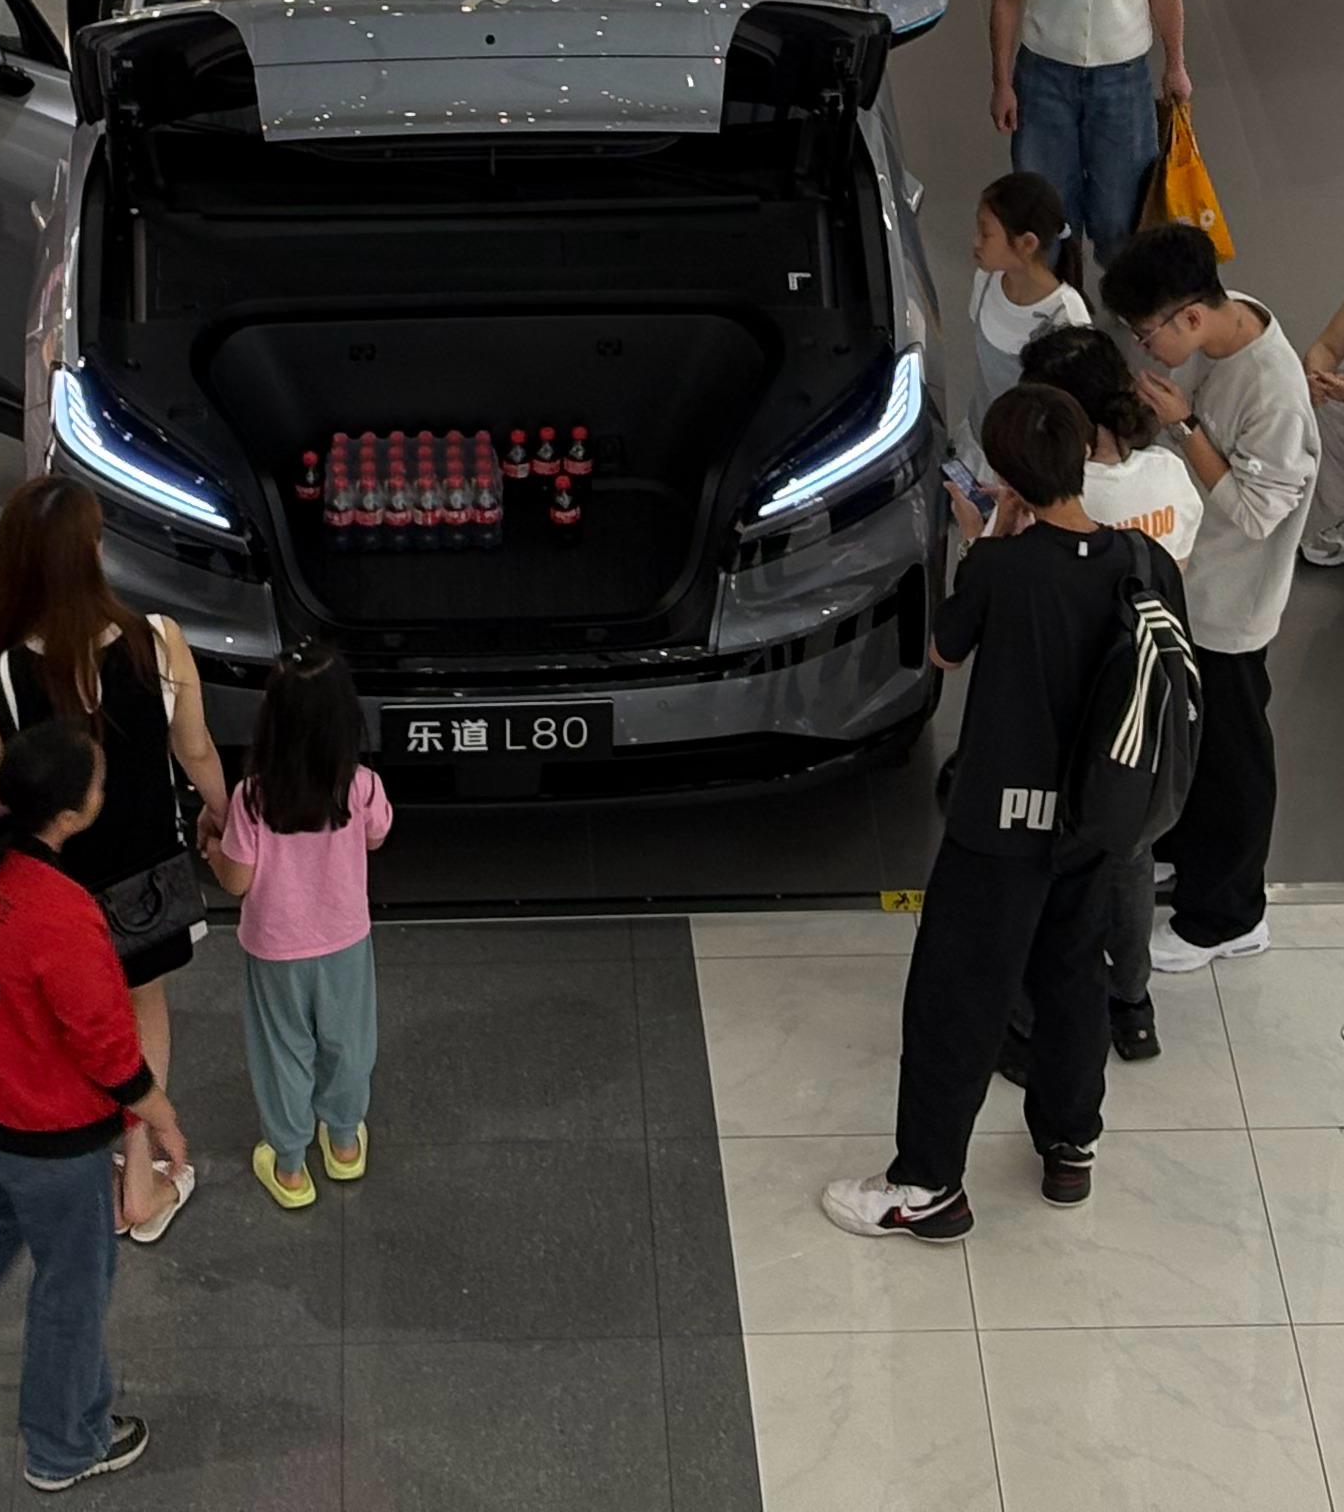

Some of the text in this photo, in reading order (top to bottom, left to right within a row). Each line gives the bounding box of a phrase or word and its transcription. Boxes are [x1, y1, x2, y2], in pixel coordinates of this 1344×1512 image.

[407, 716, 588, 753] 乐道 L80
[999, 788, 1058, 831] PU
